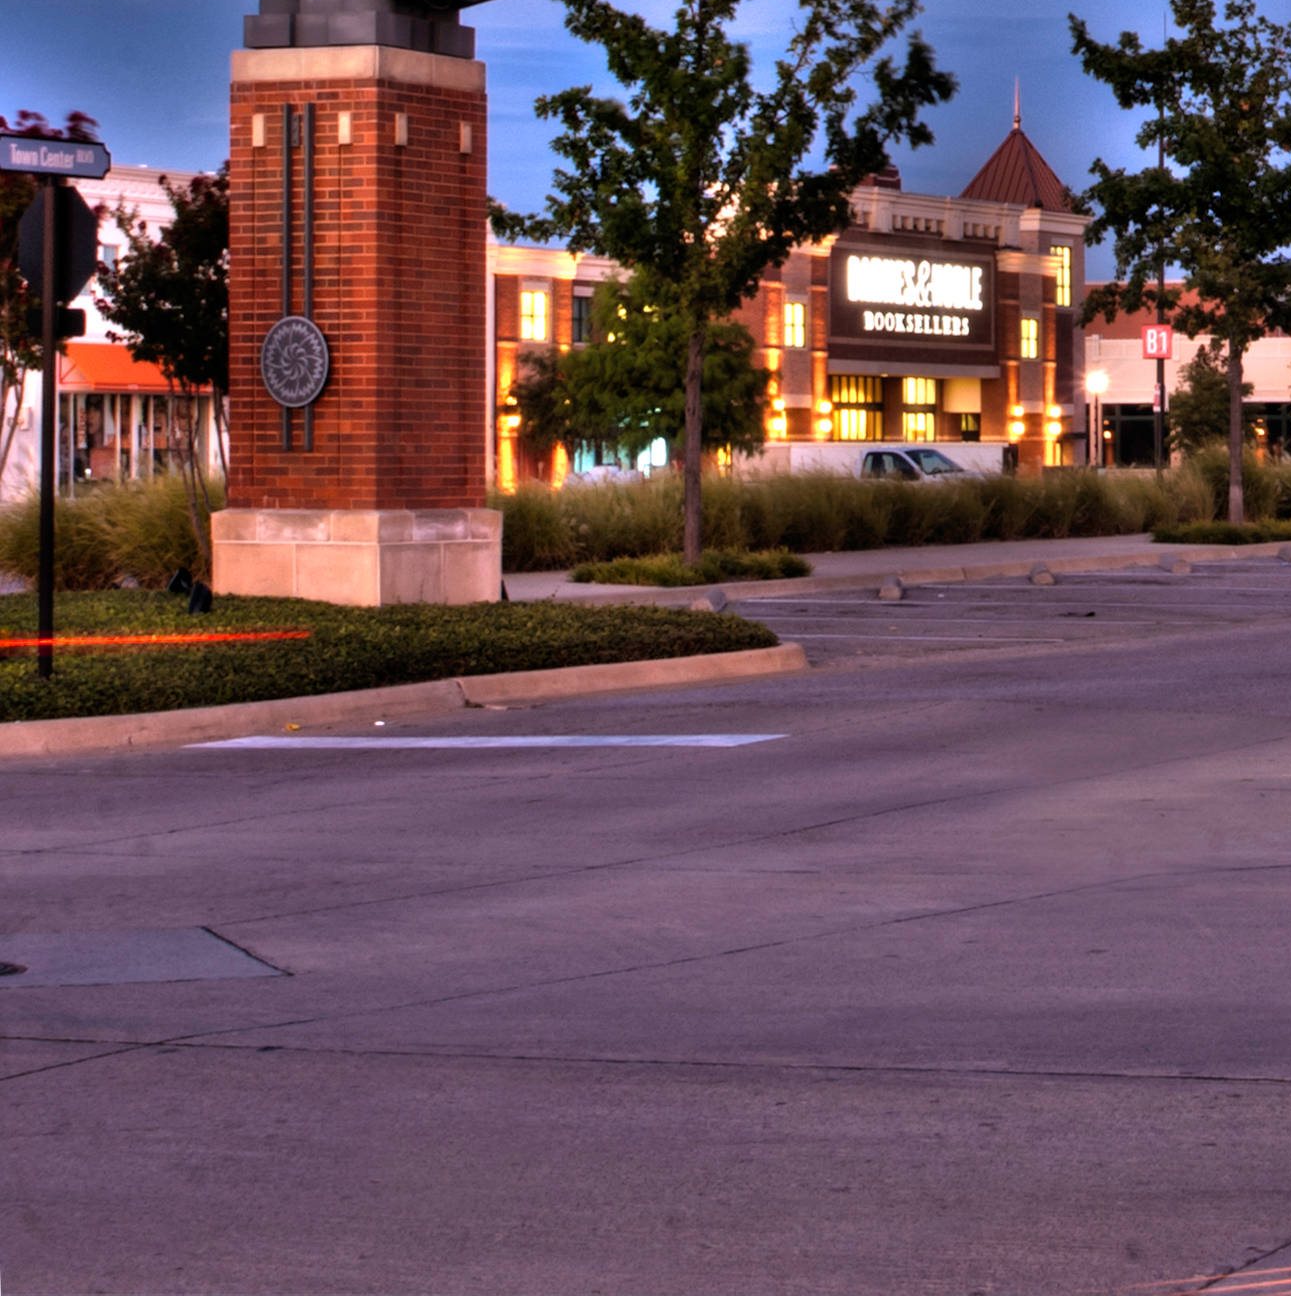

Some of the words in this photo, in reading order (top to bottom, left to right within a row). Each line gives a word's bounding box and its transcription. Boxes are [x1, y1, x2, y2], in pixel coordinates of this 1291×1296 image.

[10, 143, 38, 166] Town
[40, 146, 74, 169] Center
[863, 310, 970, 336] BOOKSELLERS
[1147, 328, 1167, 354] B1
